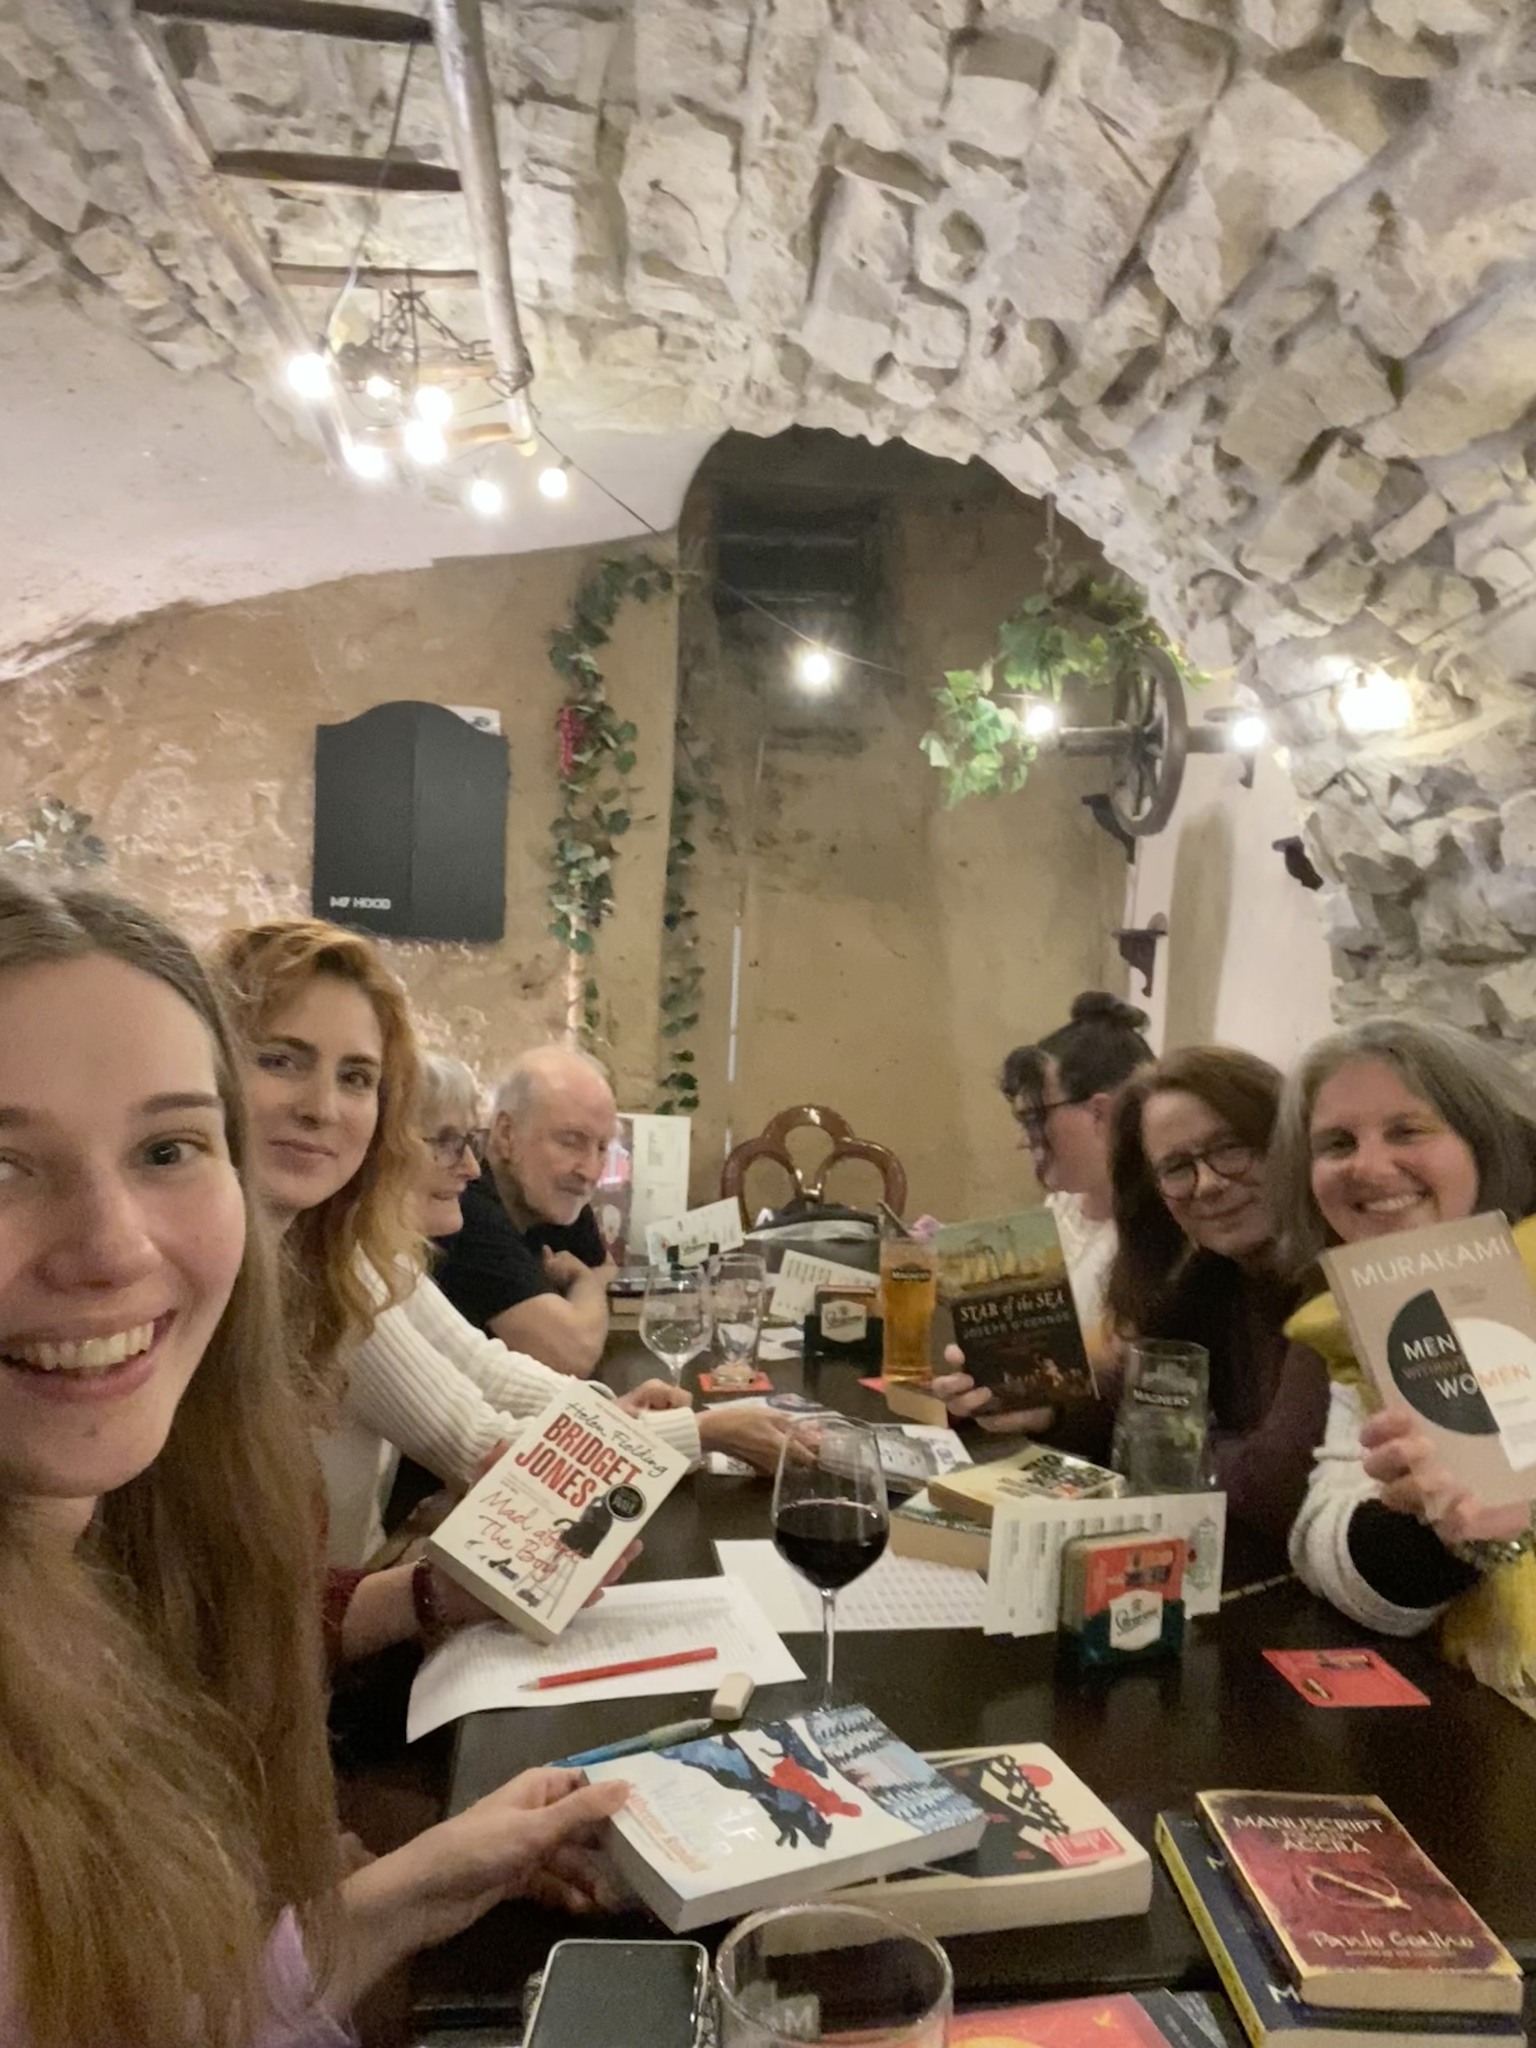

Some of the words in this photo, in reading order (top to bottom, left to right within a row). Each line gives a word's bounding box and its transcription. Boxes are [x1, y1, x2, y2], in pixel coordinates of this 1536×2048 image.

[1350, 1235, 1512, 1289] MURAKAMI
[959, 1302, 999, 1323] STAR
[1036, 1289, 1066, 1310] SEA
[1401, 1333, 1458, 1362] MEN
[542, 1411, 644, 1486] BRIDGET
[564, 1401, 608, 1438] Helen
[610, 1428, 670, 1479] Fielding
[513, 1440, 599, 1508] JONES
[478, 1490, 540, 1532] Mad
[1232, 1814, 1384, 1834] MANUSCRIPT
